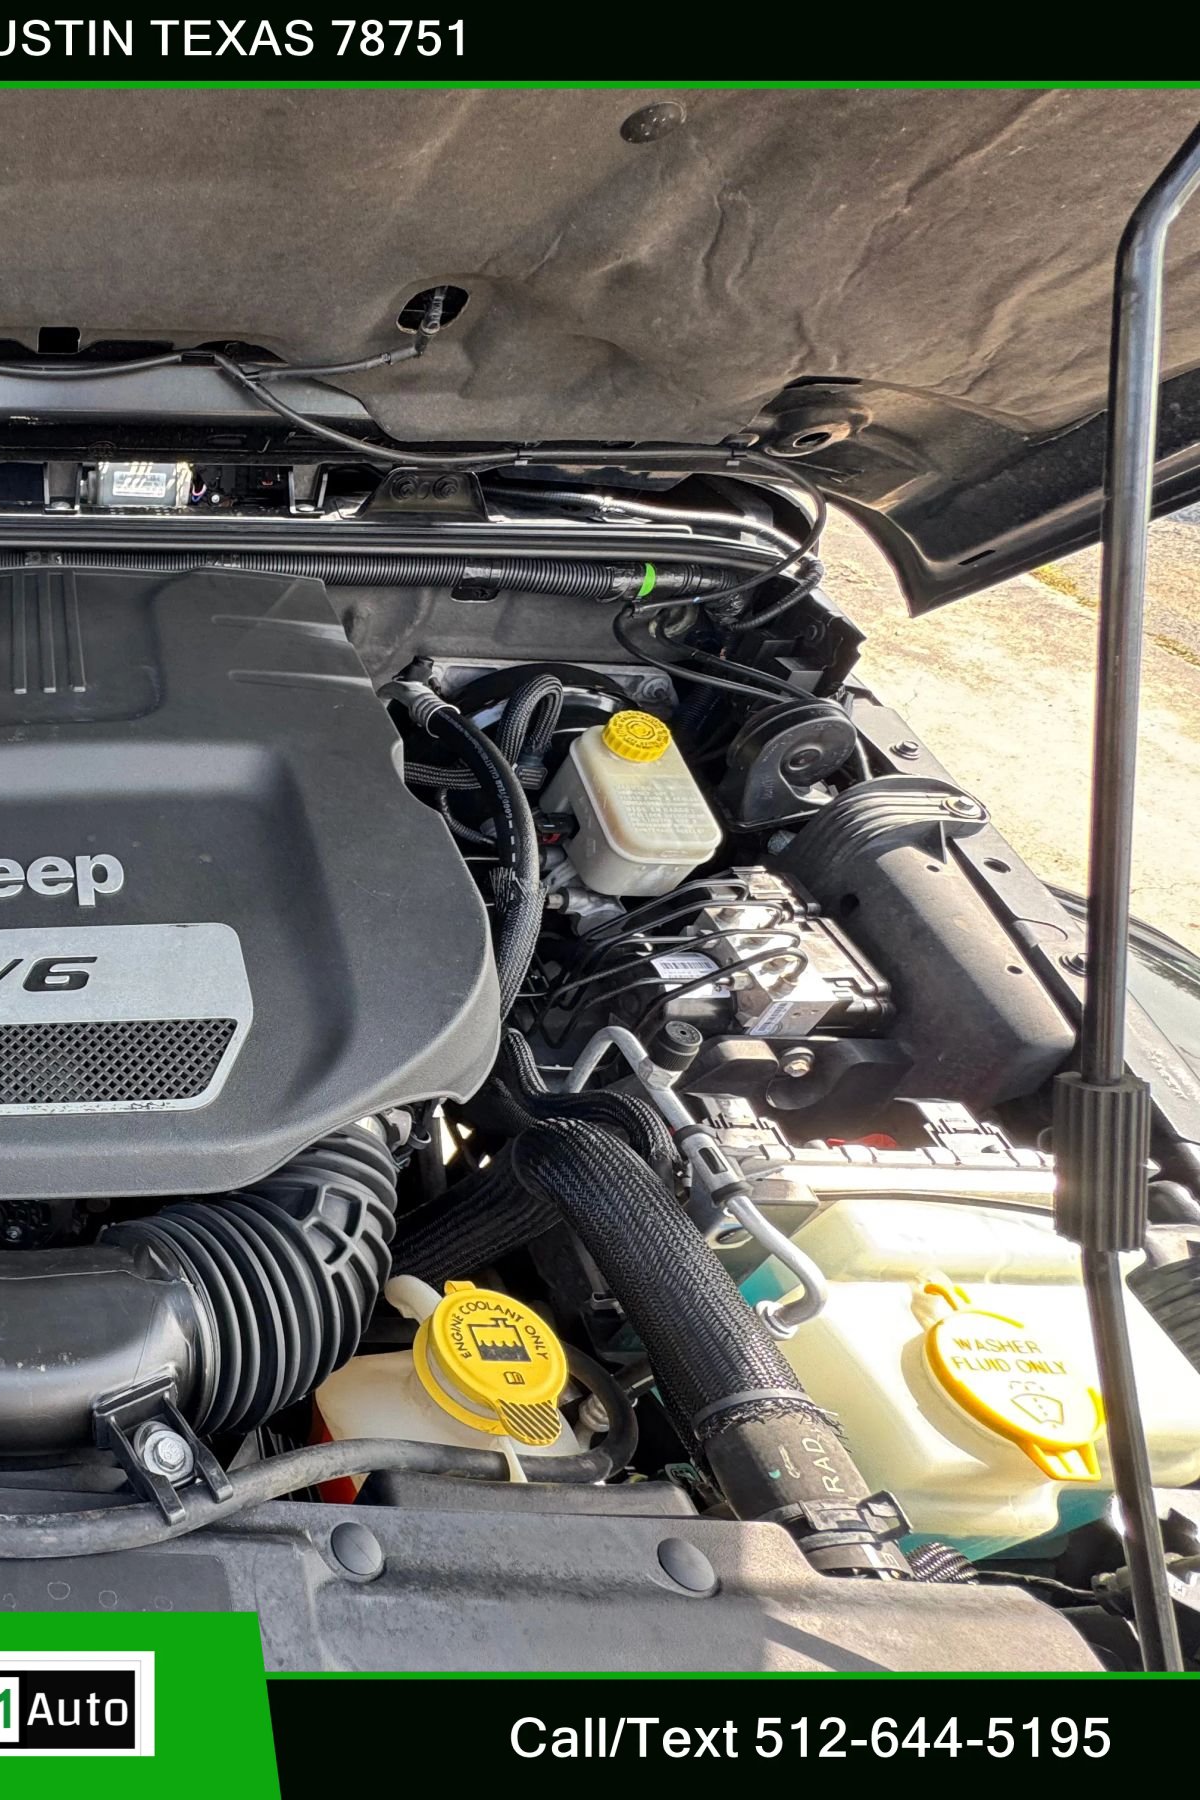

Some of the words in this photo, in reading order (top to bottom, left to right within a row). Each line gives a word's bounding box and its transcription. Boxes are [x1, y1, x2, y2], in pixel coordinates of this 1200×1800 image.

[458, 1300, 525, 1323] COOLANT
[450, 1313, 473, 1359] ENGINE
[523, 1324, 550, 1361] ONLY
[951, 1337, 1043, 1354] WASHER
[950, 1355, 1012, 1373] FLUID
[1014, 1358, 1068, 1375] ONLY
[801, 1436, 846, 1495] RAD
